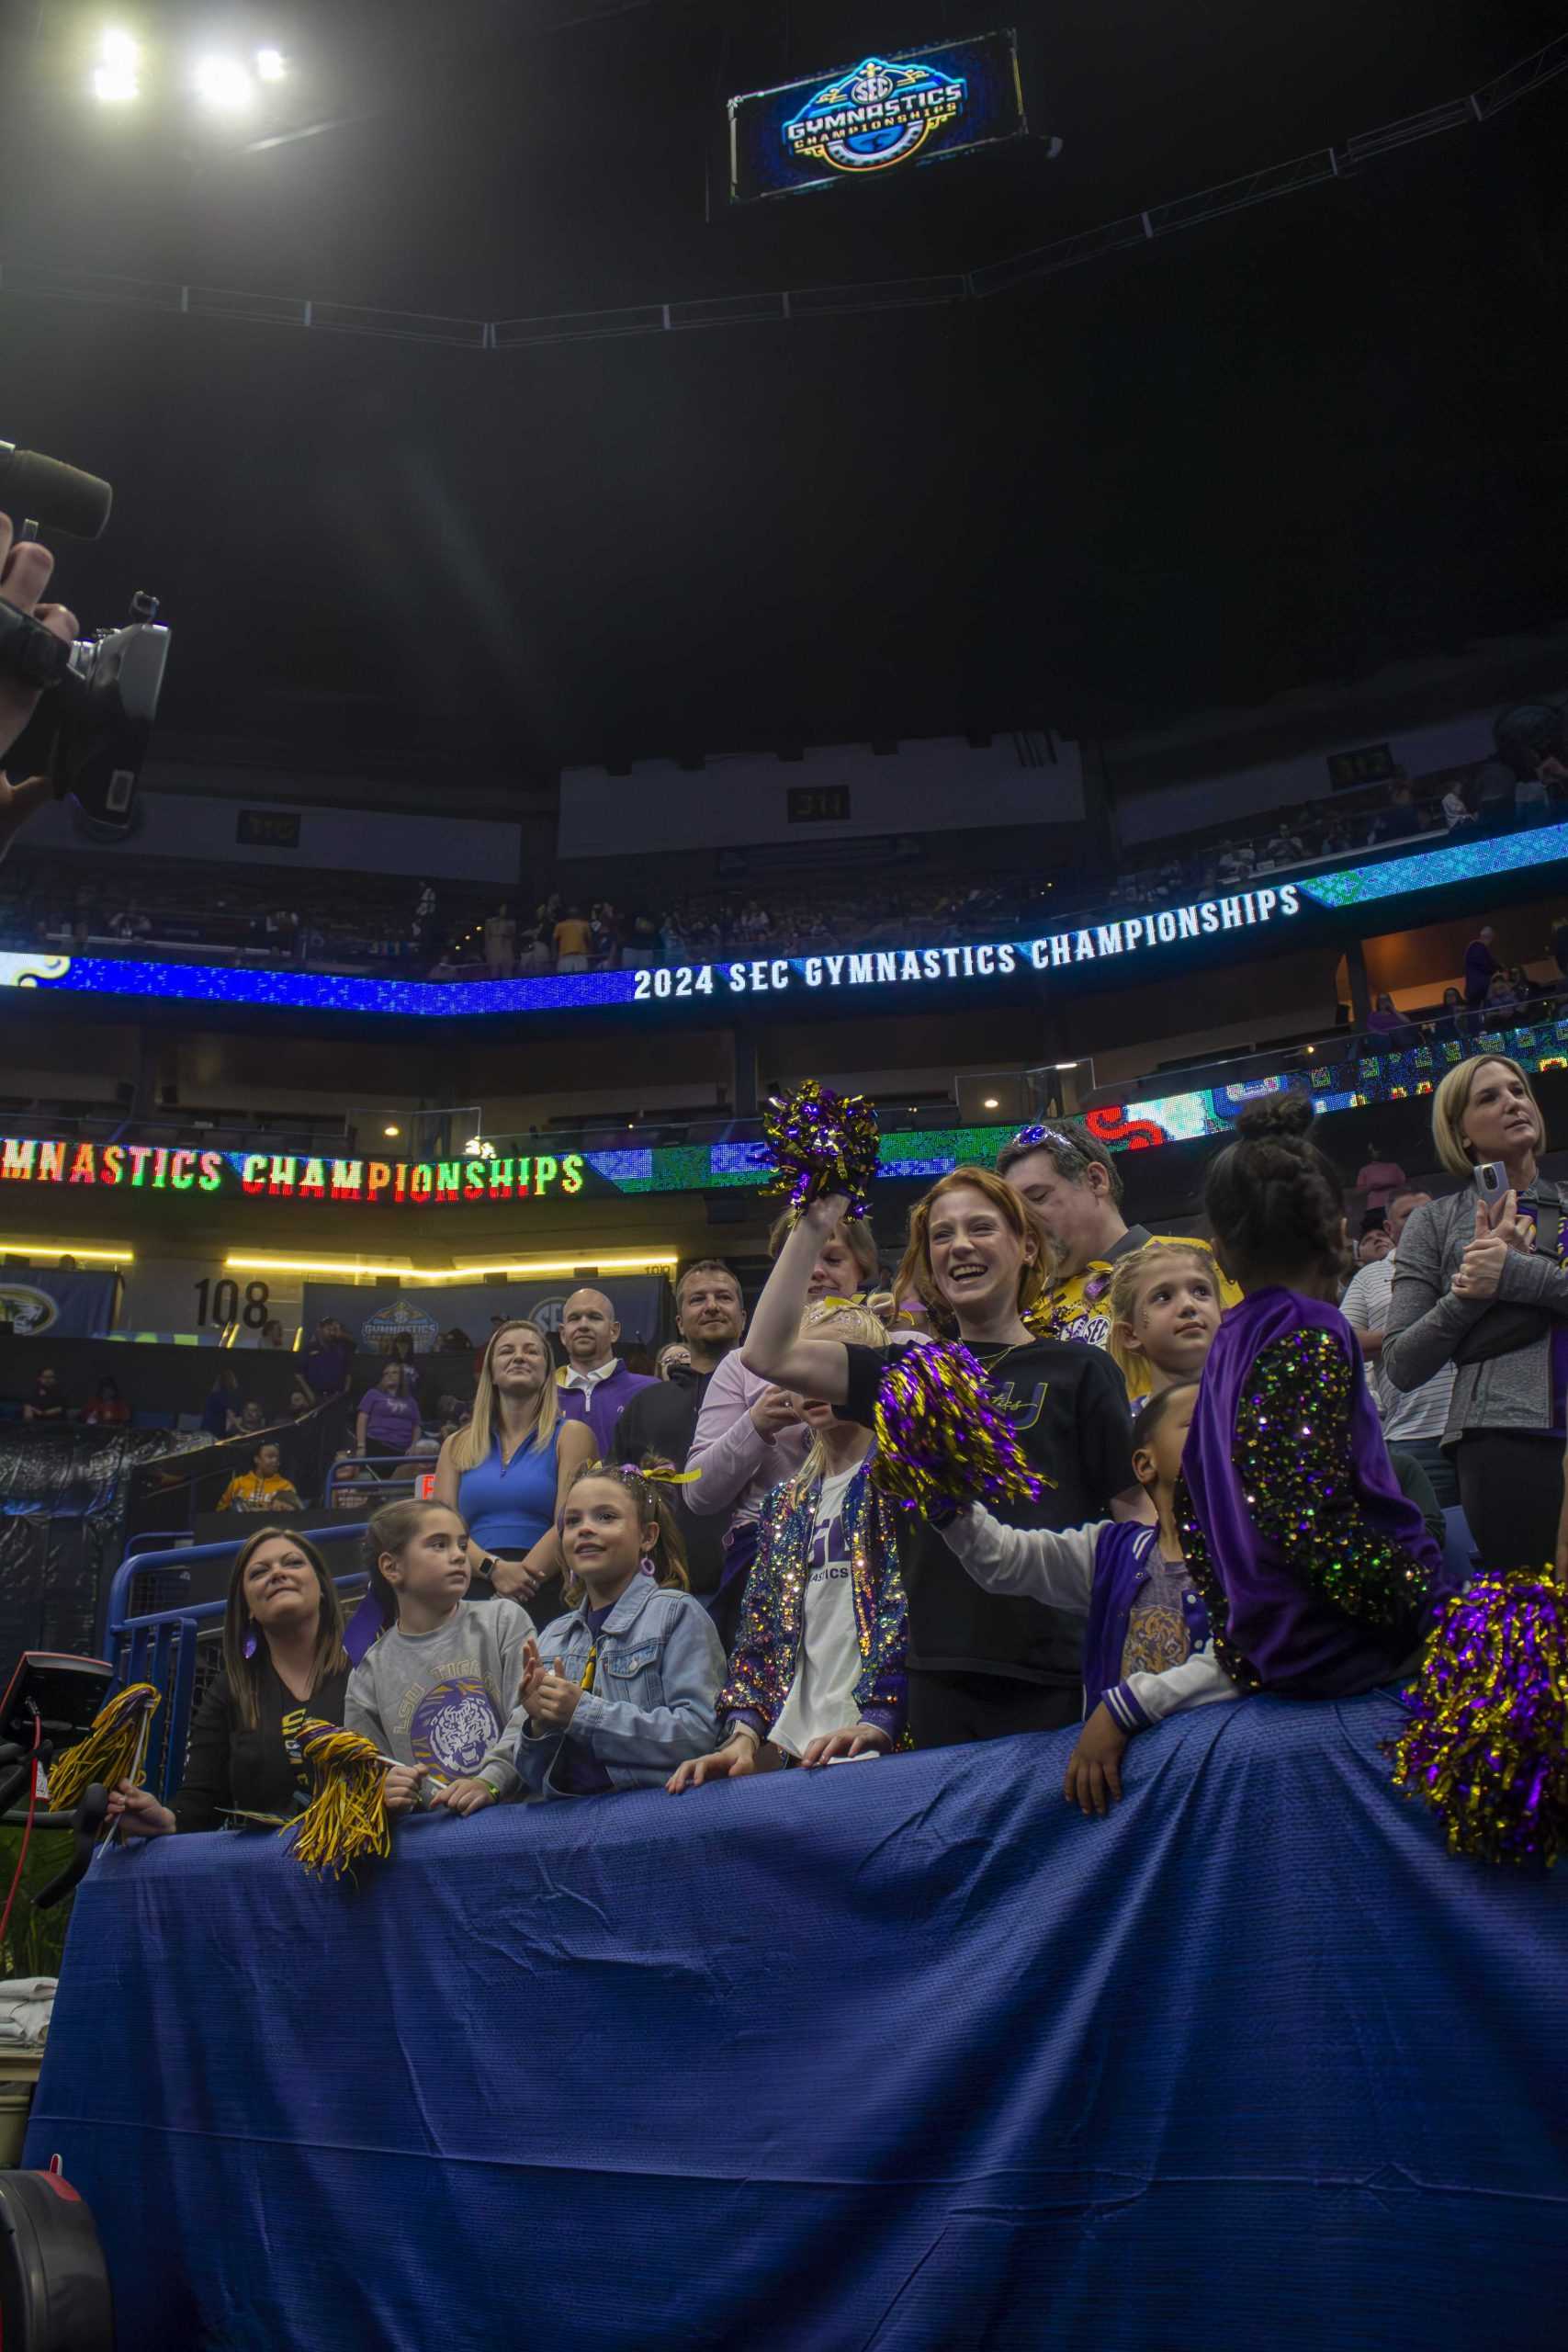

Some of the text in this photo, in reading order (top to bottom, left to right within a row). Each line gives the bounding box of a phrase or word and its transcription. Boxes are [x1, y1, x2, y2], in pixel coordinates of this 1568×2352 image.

[787, 84, 963, 140] GYMNASTICS
[855, 78, 889, 101] SEC
[794, 102, 957, 149] CHAMPIONSHIPS
[634, 884, 1300, 1000] 2024 SEC GYMNASTICS CHAMPIONSHIPS
[0, 1138, 584, 1203] MNASTICS CHAMPIONSHIPS
[194, 1279, 270, 1329] 108
[393, 1682, 427, 1735] LSU
